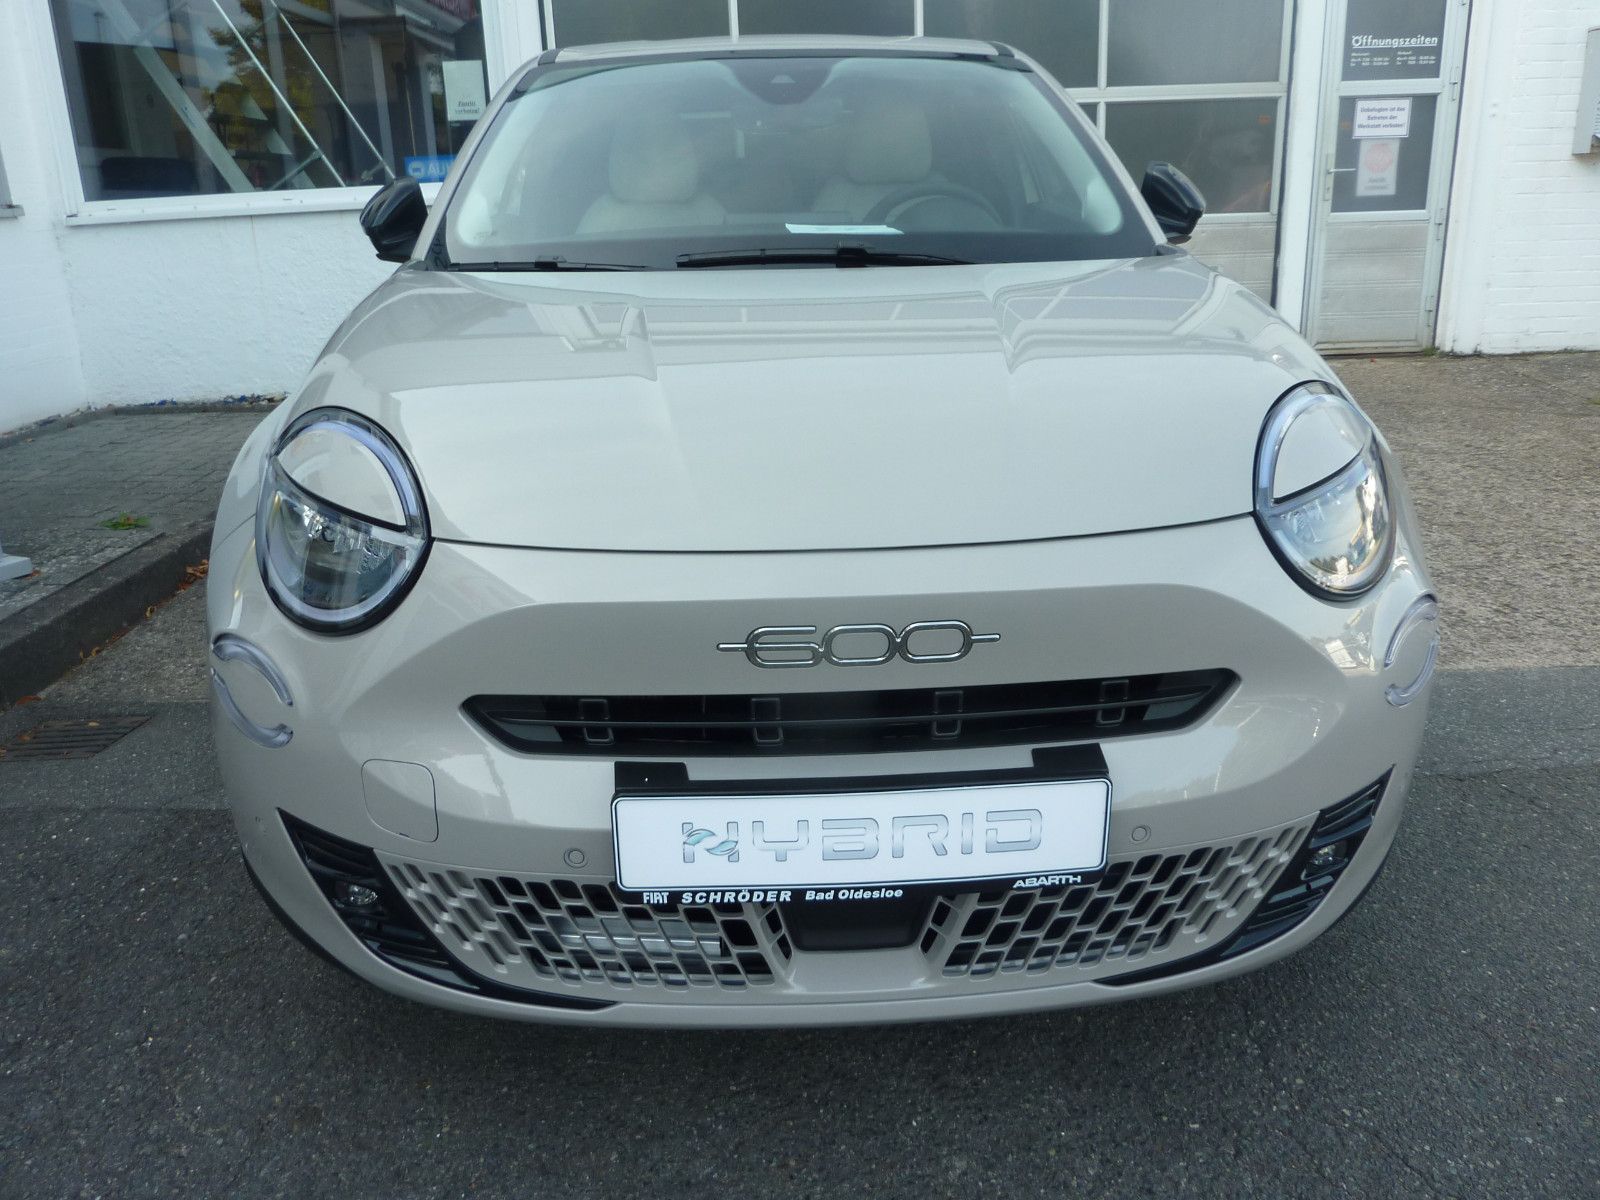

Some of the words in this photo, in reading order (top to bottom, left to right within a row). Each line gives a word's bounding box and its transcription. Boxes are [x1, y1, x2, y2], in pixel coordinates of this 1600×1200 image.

[1352, 34, 1438, 48] Öffnungszeiten
[745, 619, 973, 668] 600
[681, 808, 1043, 864] HYBRID
[1012, 874, 1082, 888] ABARTH
[642, 891, 669, 905] FIAT
[681, 889, 792, 904] SCHRÖDER
[805, 889, 836, 901] Bad
[837, 887, 904, 900] Oldesloe
